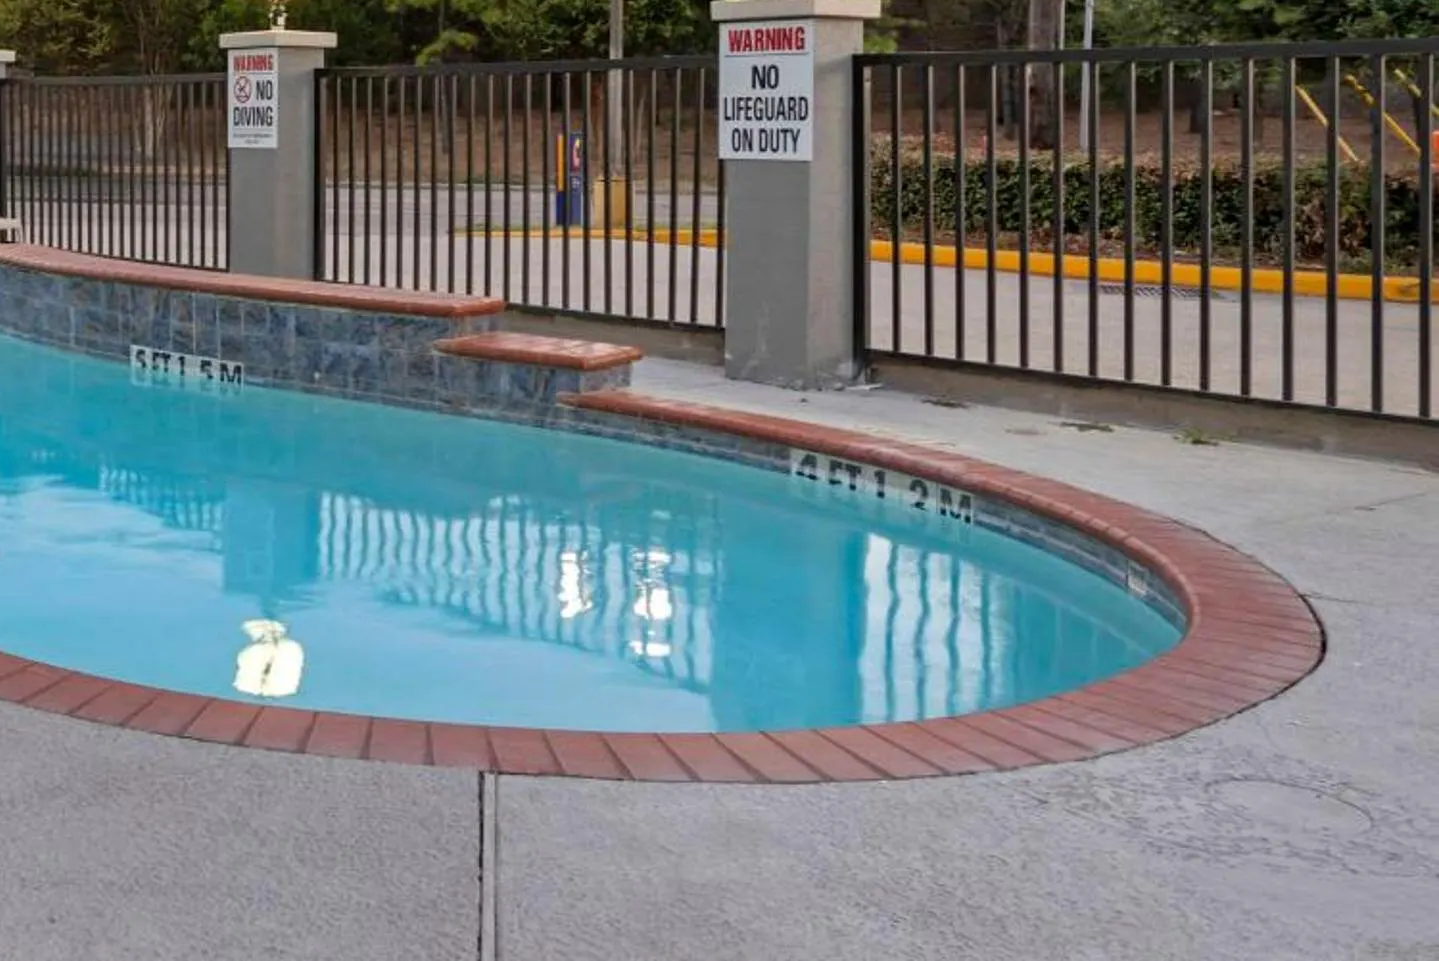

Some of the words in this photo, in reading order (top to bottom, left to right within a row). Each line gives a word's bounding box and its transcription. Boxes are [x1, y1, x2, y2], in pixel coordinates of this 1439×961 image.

[728, 26, 805, 52] WARNING
[233, 54, 273, 71] WARNING
[751, 64, 779, 89] NO
[256, 80, 273, 100] NO
[233, 107, 273, 126] DIVING
[724, 96, 809, 121] LIFEGUARD
[731, 128, 753, 152] ON
[759, 128, 801, 153] DUTY
[219, 362, 242, 385] M
[828, 458, 862, 492] FT
[939, 487, 971, 524] M
